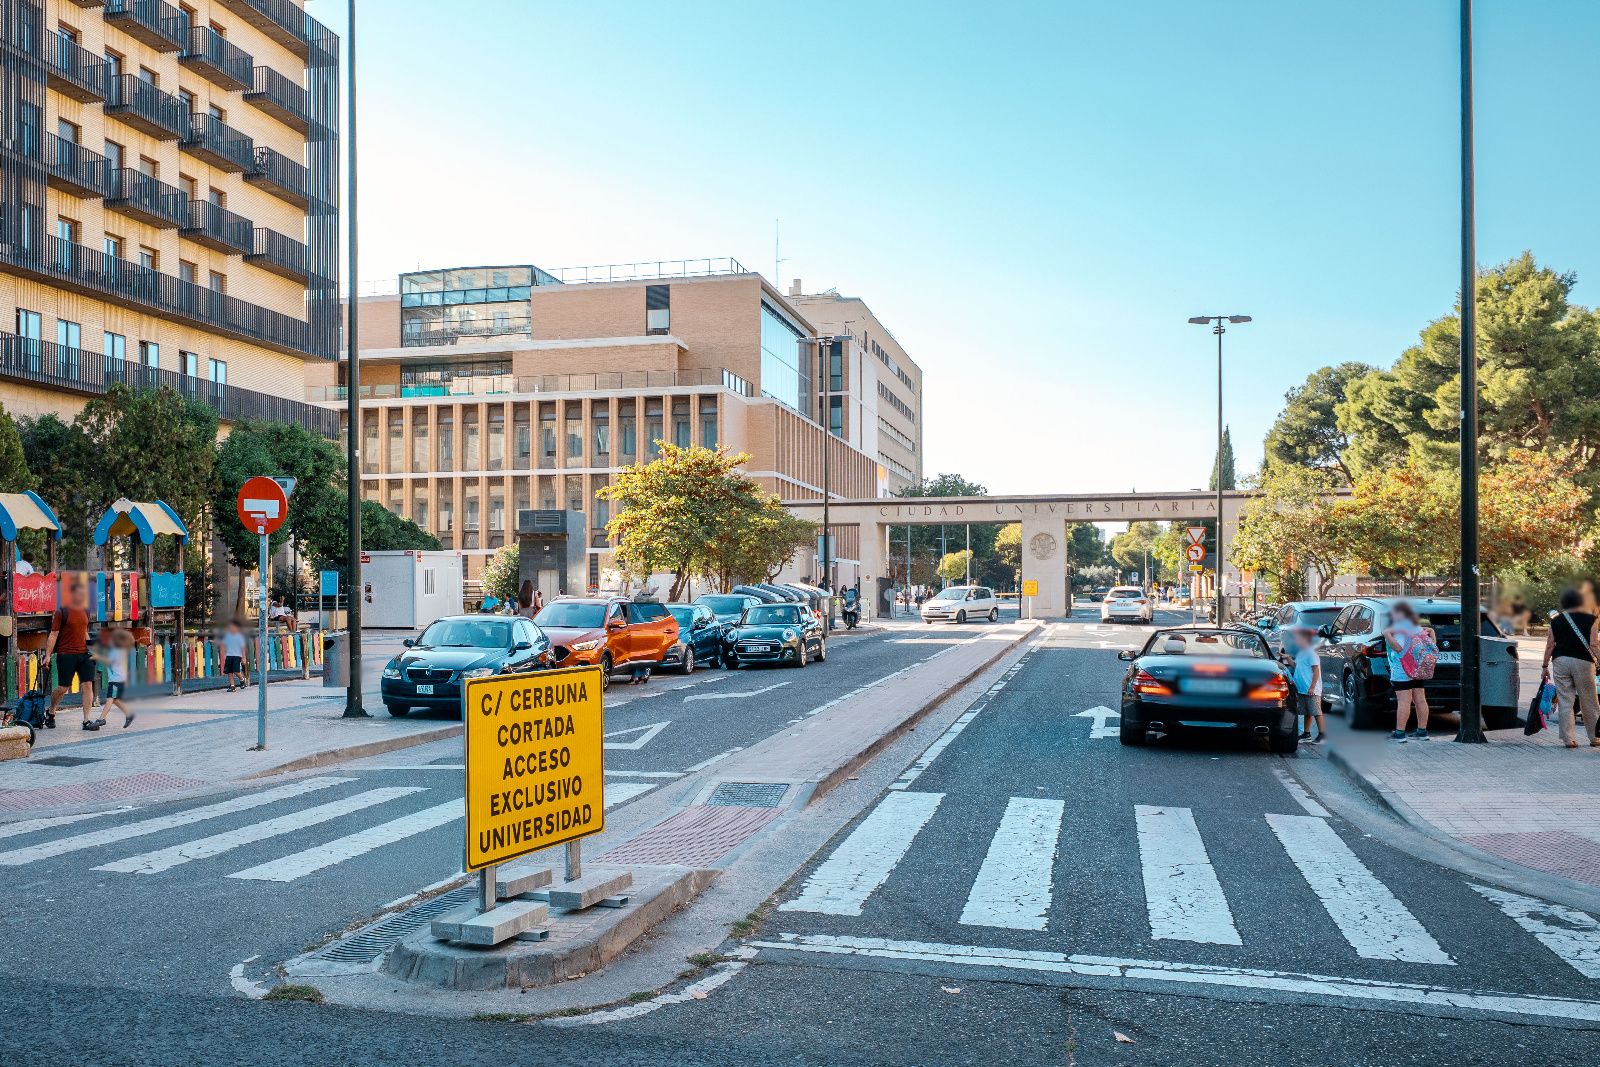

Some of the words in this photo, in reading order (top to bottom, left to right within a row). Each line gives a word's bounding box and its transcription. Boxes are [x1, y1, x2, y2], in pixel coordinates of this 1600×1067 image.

[880, 506, 964, 516] CIUDAD
[996, 501, 1215, 515] UNIVERSITARIA
[481, 691, 502, 716] C/
[510, 682, 587, 711] CERBUNA
[498, 715, 575, 747] CORTADA
[503, 747, 570, 780] ACCESO
[491, 776, 582, 816] EXCLUSIVO
[480, 804, 591, 853] UNIVERSIDAD
